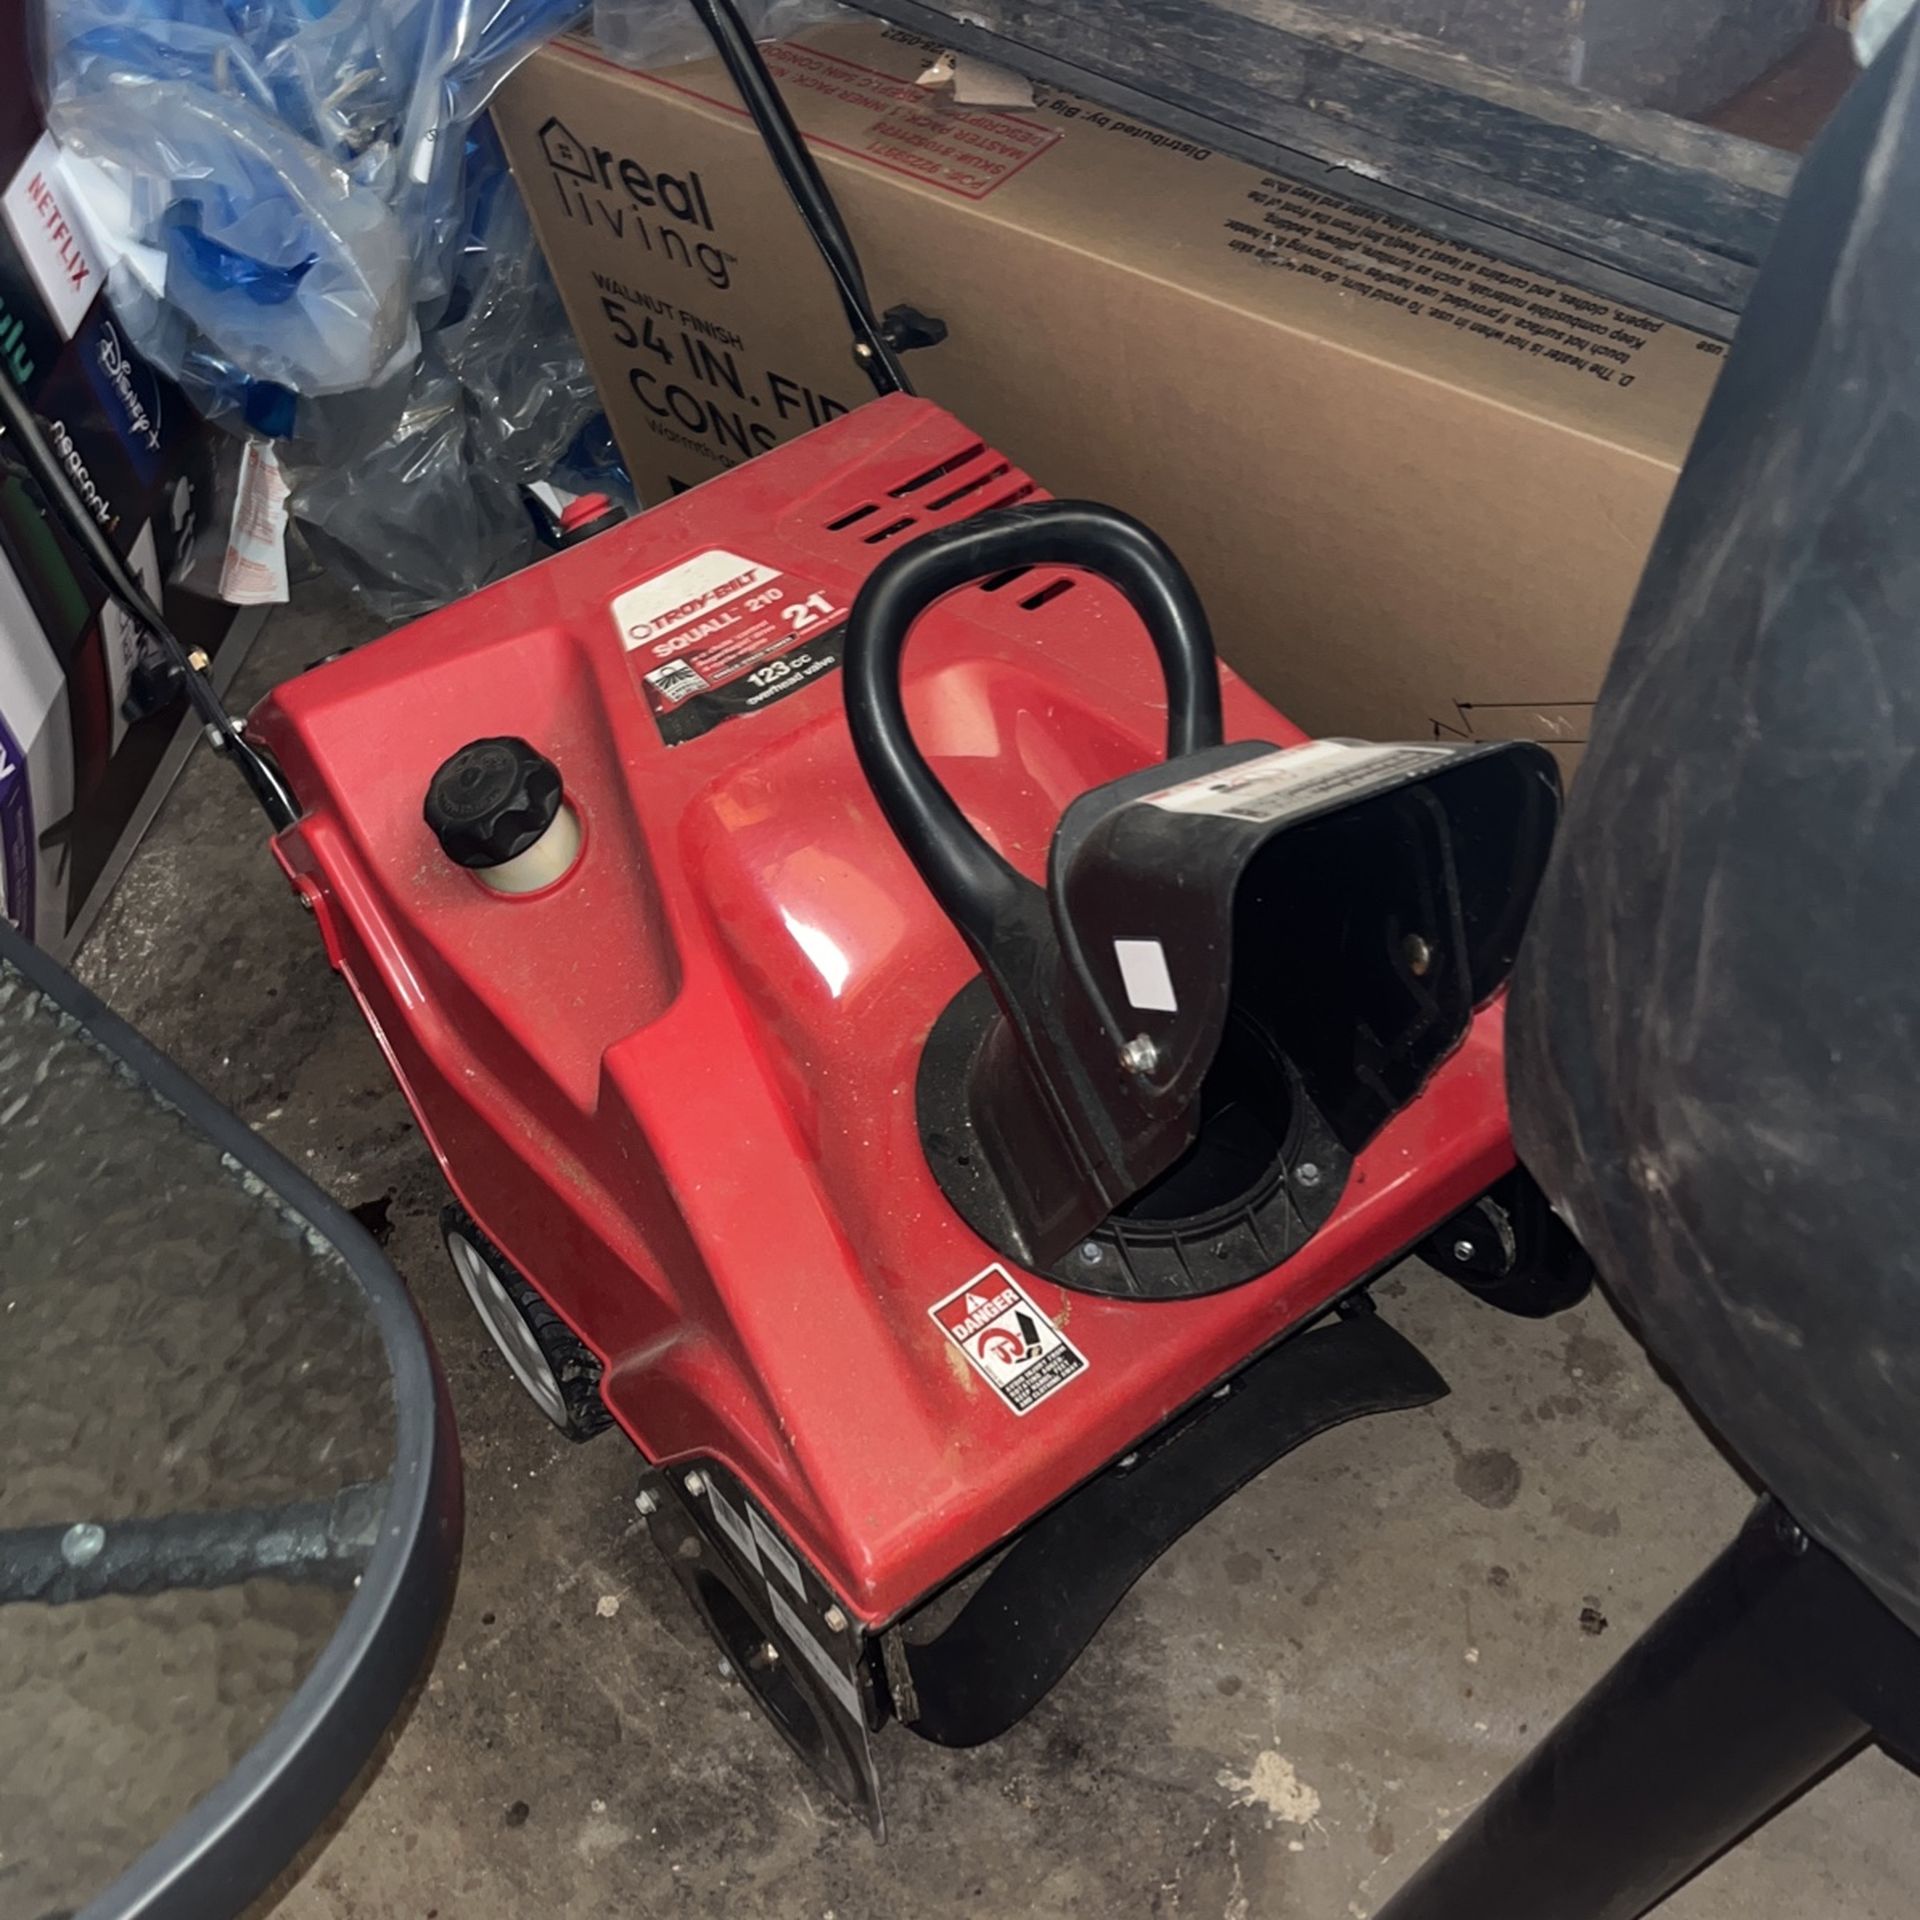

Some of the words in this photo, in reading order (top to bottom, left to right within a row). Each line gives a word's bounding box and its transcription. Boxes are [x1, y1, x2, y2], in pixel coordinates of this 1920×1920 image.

[837, 90, 888, 111] INNER
[1049, 100, 1081, 117] Big
[1080, 112, 1111, 127] by:
[953, 130, 1027, 160] MASTER
[1108, 122, 1212, 160] Distributed
[594, 144, 713, 231] real
[1248, 191, 1268, 206] the
[1310, 212, 1332, 224] the
[27, 171, 91, 292] NETFLIX
[1314, 229, 1362, 251] pillows,
[1228, 240, 1256, 253] skin
[1285, 238, 1332, 263] moving
[1361, 244, 1415, 272] furniture,
[1460, 261, 1477, 271] at
[1297, 264, 1322, 276] not
[1320, 271, 1339, 283] do
[1365, 267, 1414, 290] handles
[1415, 265, 1433, 275] as
[1431, 271, 1465, 286] such
[1476, 266, 1529, 293] curtains
[1341, 276, 1373, 298] burn,
[1371, 289, 1409, 306] avoid
[1414, 284, 1440, 296] use
[1467, 280, 1528, 308] materials,
[1527, 284, 1556, 297] and
[592, 272, 673, 320] WALNUT
[678, 310, 744, 351] FINISH
[1407, 301, 1424, 315] To
[1428, 307, 1454, 321] use.
[1440, 291, 1503, 323] provided,
[1559, 292, 1609, 315] clothes,
[1454, 316, 1470, 329] in
[1495, 309, 1512, 324] If
[1527, 303, 1609, 335] combustible
[1613, 309, 1664, 333] papers,
[1469, 322, 1505, 339] when
[1514, 317, 1566, 345] surface.
[1609, 329, 1646, 350] Keep
[601, 297, 673, 365] 54
[678, 333, 761, 406] IN.
[1503, 334, 1530, 350] hot
[1529, 343, 1544, 356] is
[1563, 335, 1590, 351] hot
[1543, 349, 1588, 370] heater
[1589, 344, 1630, 364] touch
[1589, 364, 1615, 381] The
[1618, 373, 1635, 387] D.
[98, 321, 160, 448] Disney+
[650, 568, 758, 630] TROY-BILT
[744, 588, 783, 611] 210
[747, 671, 804, 704] overhead
[803, 656, 835, 674] valve
[952, 1289, 1022, 1340] DANGER
[1006, 1376, 1025, 1392] AVOID
[1025, 1360, 1046, 1377] INJURY
[1047, 1346, 1065, 1360] FROM
[1010, 1373, 1041, 1397] ROTATING
[1015, 1389, 1030, 1402] KEEP
[1053, 1360, 1069, 1373] FEET
[1020, 1397, 1032, 1407] AND
[1033, 1376, 1061, 1398] CLOTHING
